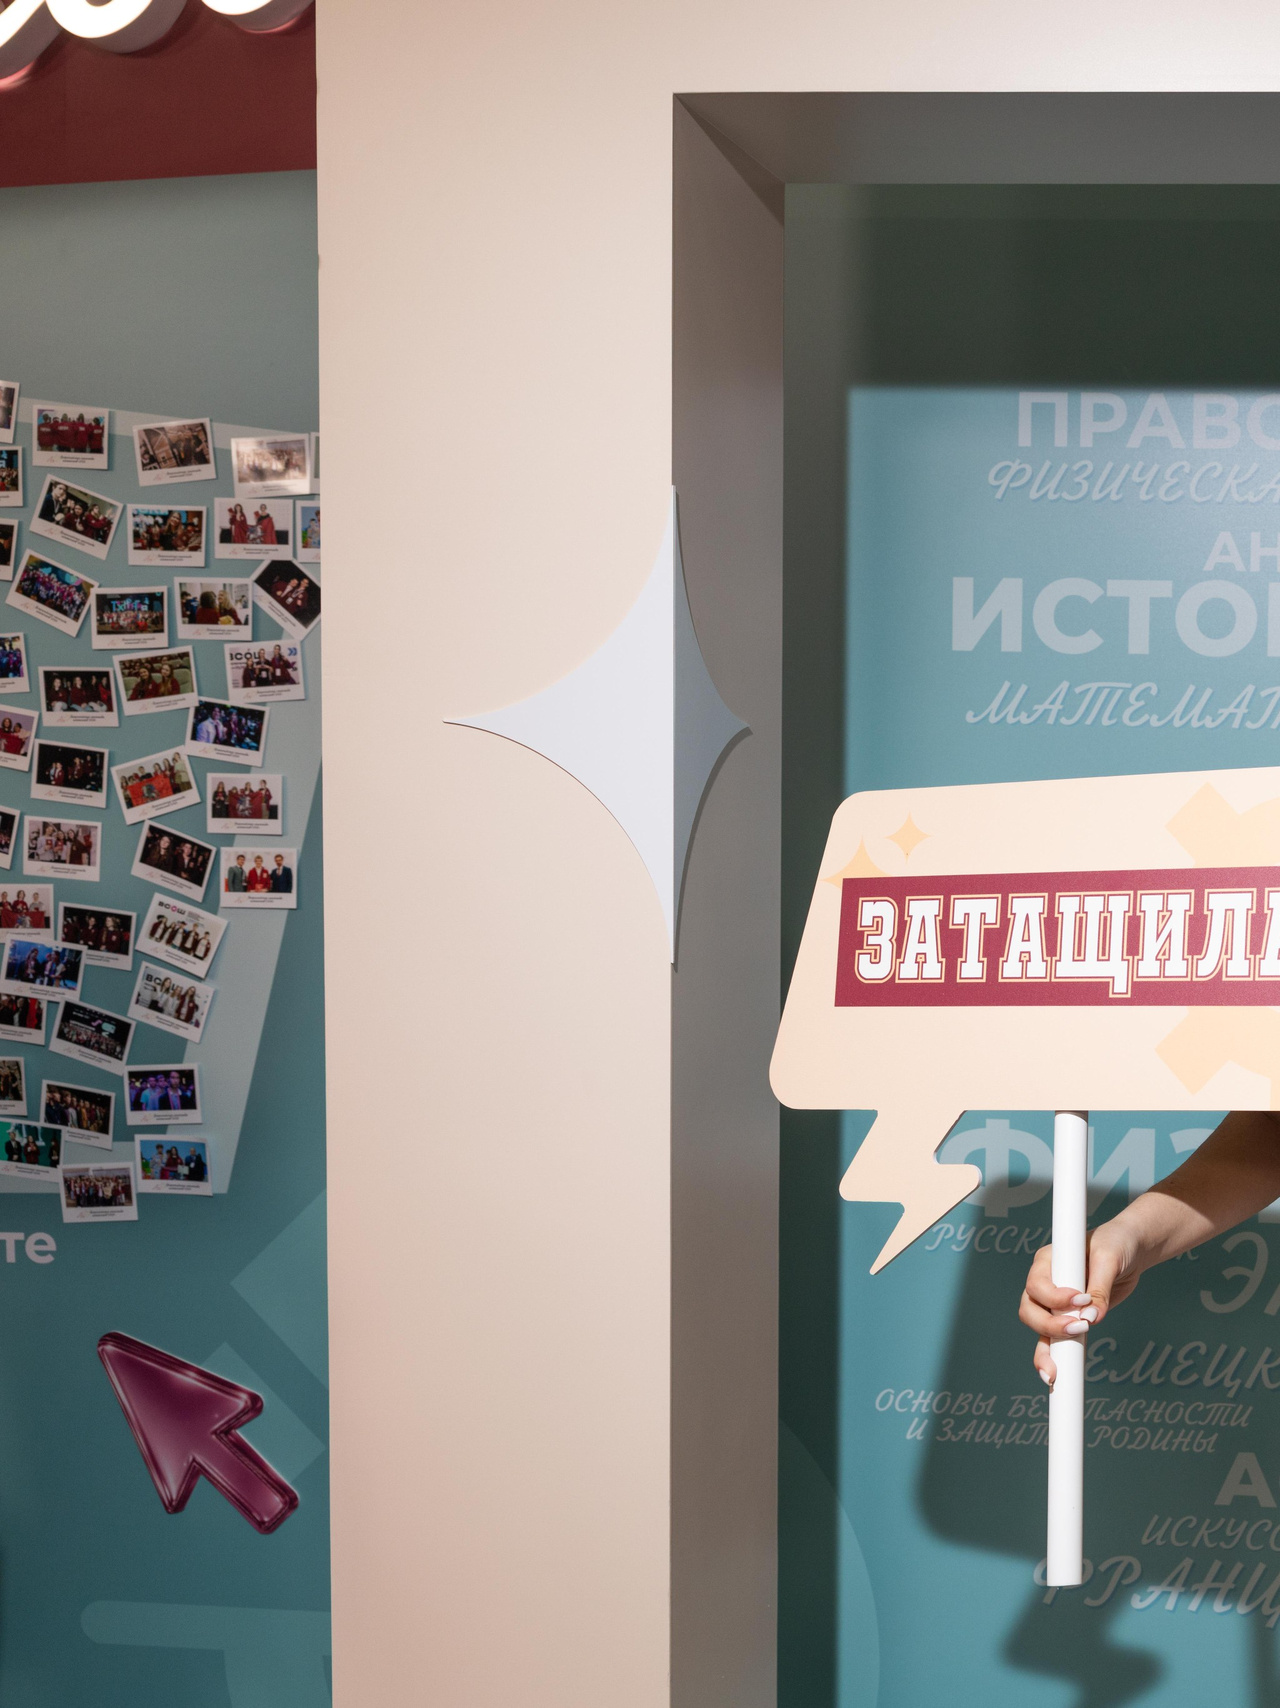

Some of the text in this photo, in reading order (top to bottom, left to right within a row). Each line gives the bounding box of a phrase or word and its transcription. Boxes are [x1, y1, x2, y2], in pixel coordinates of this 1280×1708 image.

[874, 1388, 996, 1416] ОСНОВЫ
[905, 1417, 1220, 1454] И ЗАЩИТ РОДИНЫ
